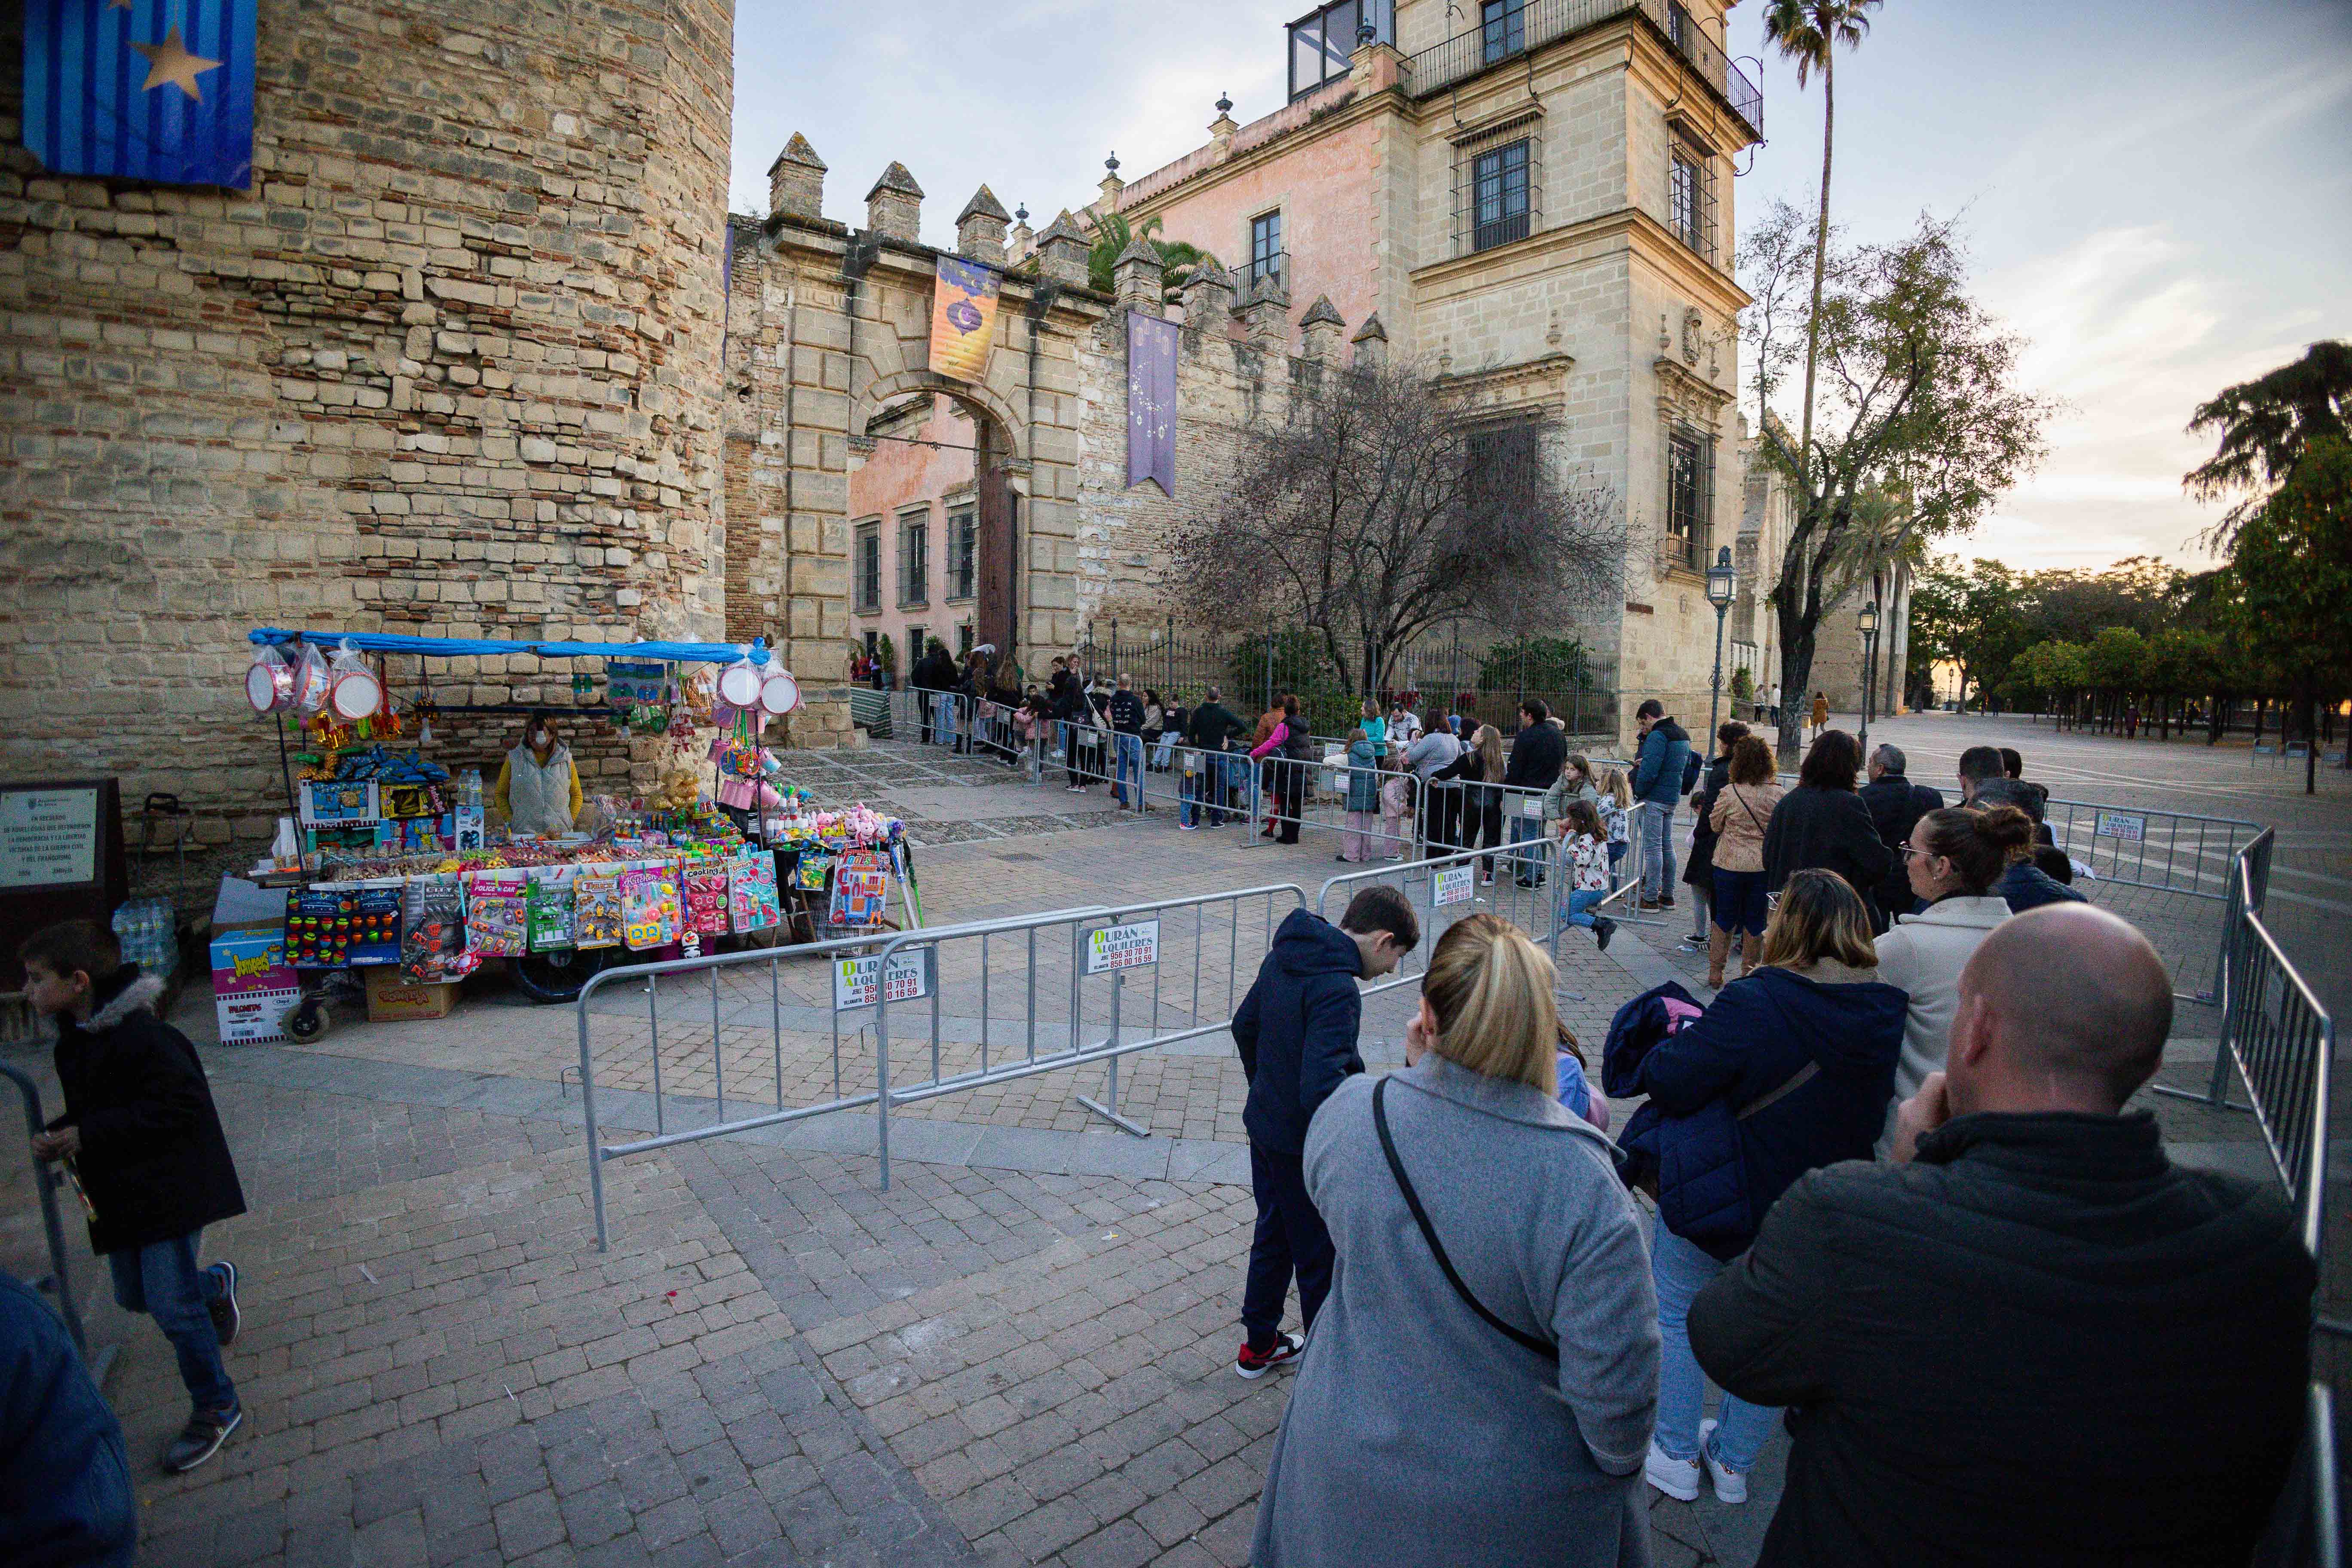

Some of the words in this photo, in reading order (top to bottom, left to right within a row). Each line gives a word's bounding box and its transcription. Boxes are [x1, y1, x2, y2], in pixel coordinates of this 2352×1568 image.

[1094, 926, 1138, 944] DURÁN
[1094, 937, 1152, 954] ALQUILERES
[1111, 952, 1122, 960] 956
[1110, 960, 1122, 968] 856
[895, 980, 905, 989] 70
[907, 978, 916, 987] 91
[895, 989, 905, 998] 16
